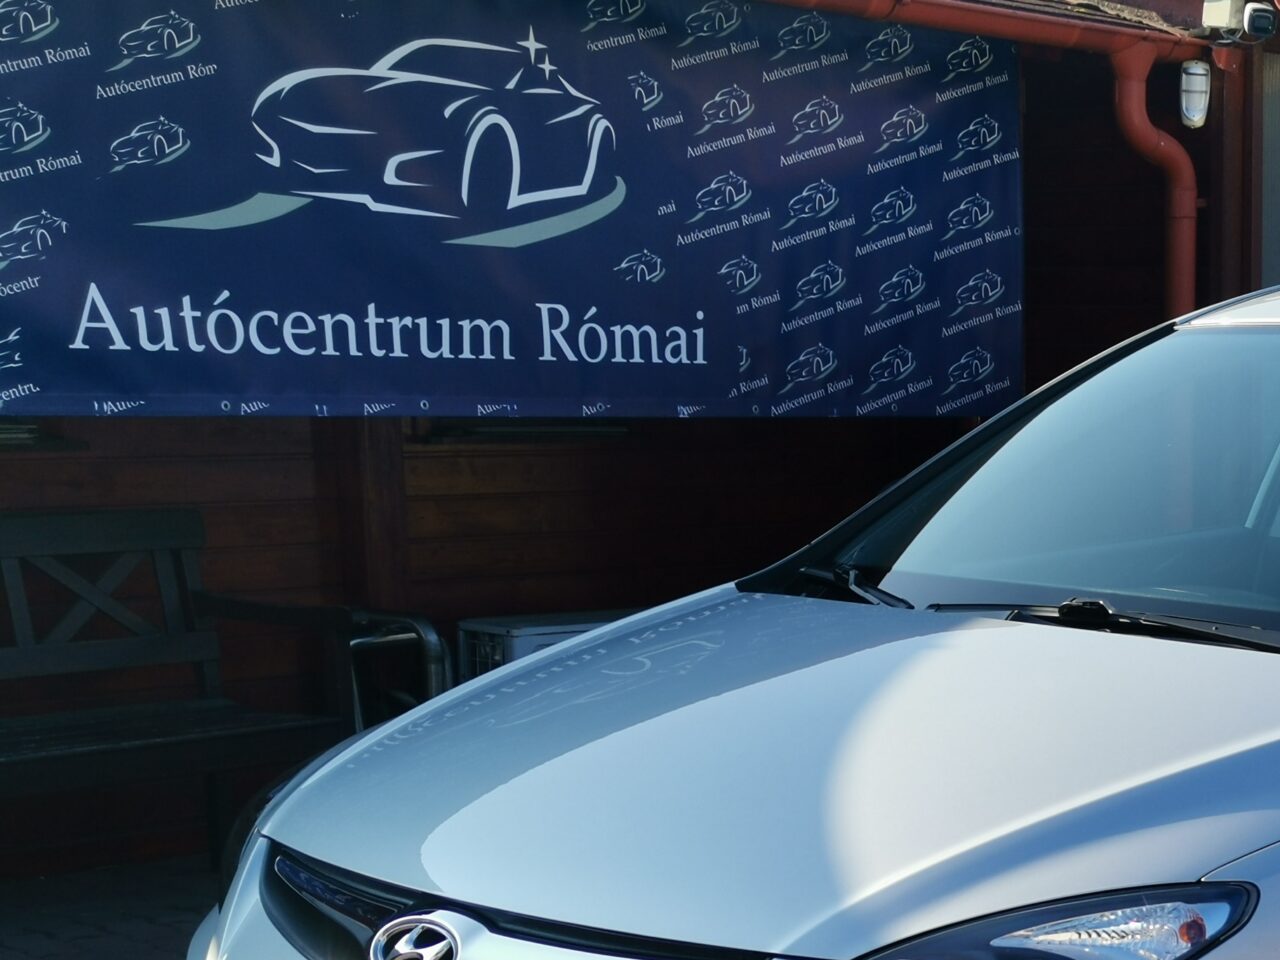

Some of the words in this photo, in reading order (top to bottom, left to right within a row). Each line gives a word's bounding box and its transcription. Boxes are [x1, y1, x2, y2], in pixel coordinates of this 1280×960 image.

[44, 42, 91, 64] Római
[670, 47, 728, 71] Autócentrum
[729, 36, 761, 56] Római
[762, 58, 819, 83] Autócentrum
[820, 49, 849, 66] Római
[96, 70, 185, 99] Autócentrum
[849, 71, 903, 94] Autócentrum
[904, 59, 931, 78] Római
[652, 110, 684, 130] Római
[686, 132, 745, 158] Autócentrum
[746, 122, 777, 142] Római
[779, 142, 836, 167] Autócentrum
[836, 131, 865, 149] Római
[866, 151, 918, 175] Autócentrum
[918, 139, 944, 158] Római
[36, 150, 82, 173] Római
[942, 159, 992, 182] Autócentrum
[992, 147, 1020, 165] Római
[676, 219, 740, 247] Autócentrum
[741, 207, 772, 228] Római
[771, 225, 828, 252] Autócentrum
[828, 213, 856, 232] Római
[855, 233, 907, 258] Autócentrum
[907, 219, 934, 239] Római
[933, 238, 984, 262] Autócentrum
[984, 225, 1012, 244] Római
[750, 290, 780, 309] Római
[780, 306, 836, 334] Autócentrum
[836, 293, 863, 311] Római
[864, 310, 915, 336] Autócentrum
[915, 297, 941, 316] Római
[68, 282, 516, 360] Autócentrum
[535, 303, 708, 364] Római
[941, 312, 994, 338] Autócentrum
[994, 300, 1022, 319] Római
